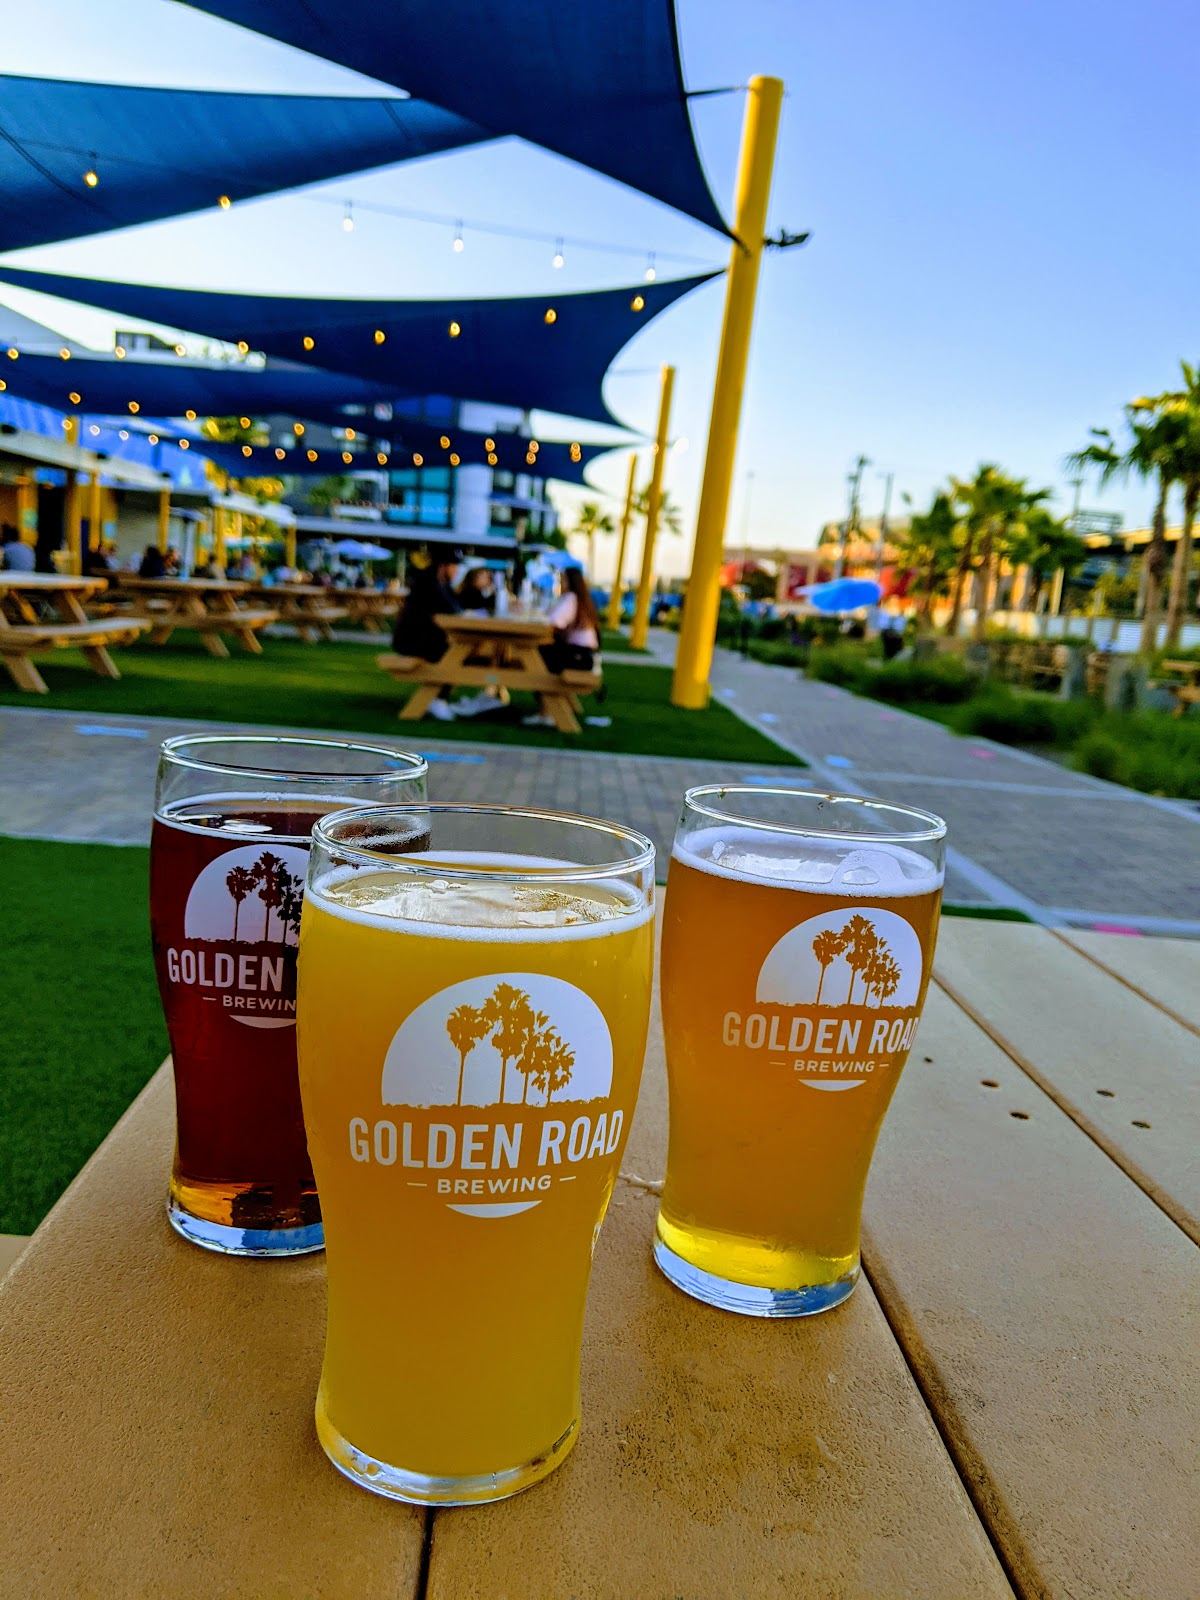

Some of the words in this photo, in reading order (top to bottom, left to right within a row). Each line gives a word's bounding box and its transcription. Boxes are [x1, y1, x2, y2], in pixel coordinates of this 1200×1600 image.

[167, 947, 284, 992] GOLDEN
[222, 995, 296, 1012] BREWIN
[722, 1011, 861, 1055] GOLDEN
[793, 1059, 876, 1074] BREWING
[349, 1116, 524, 1170] GOLDEN
[537, 1109, 624, 1167] ROAD
[436, 1174, 552, 1195] BREWING
